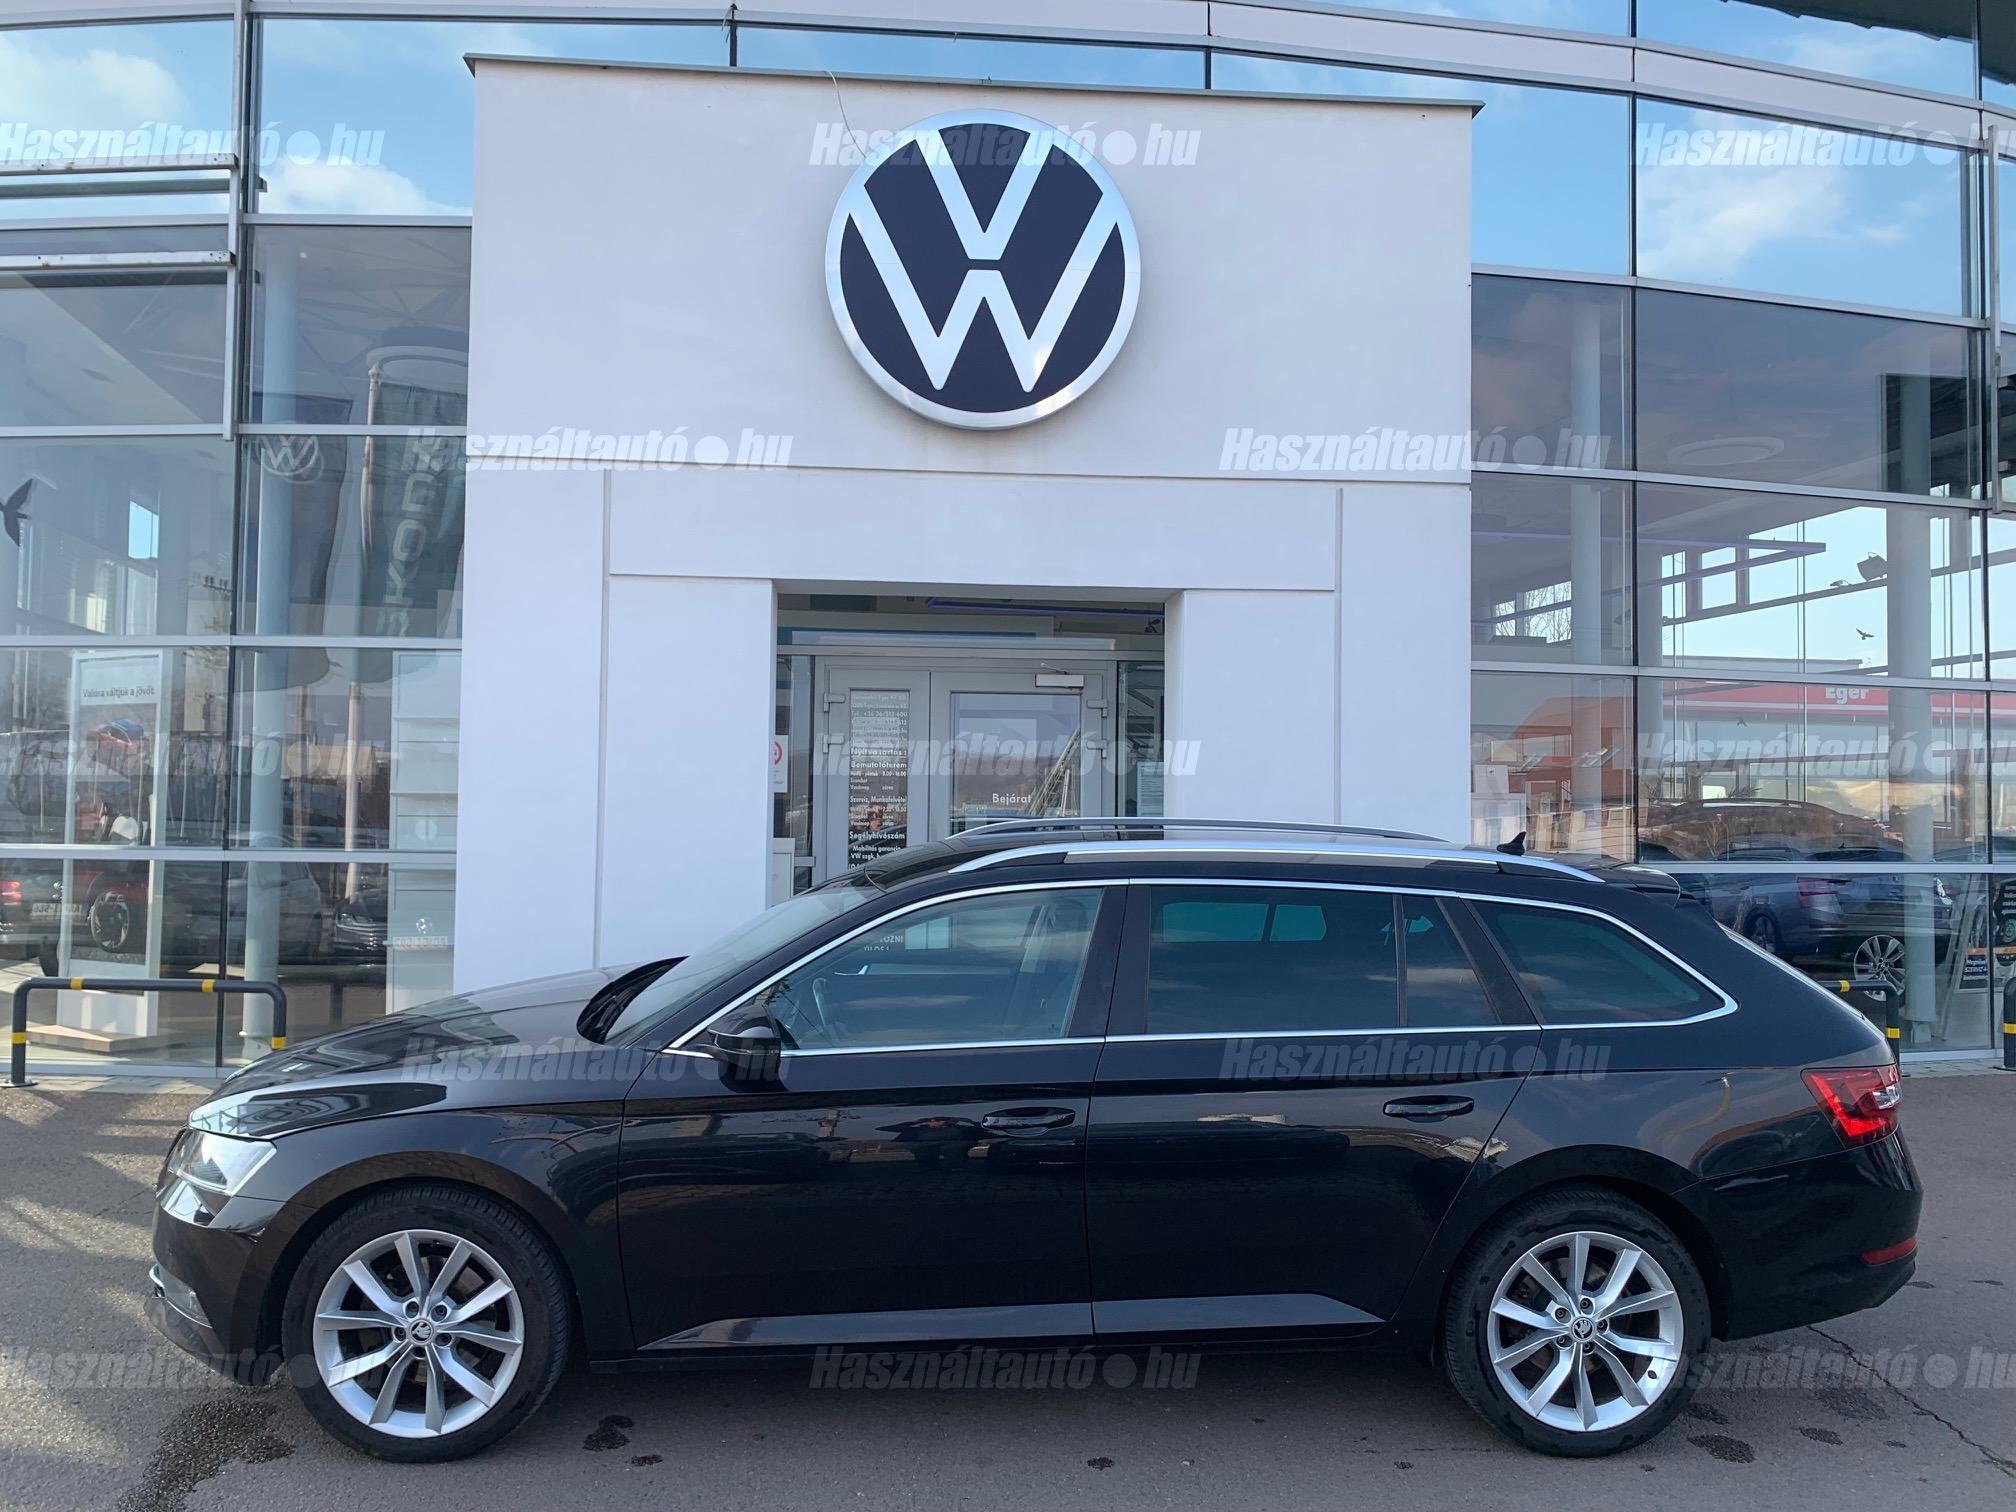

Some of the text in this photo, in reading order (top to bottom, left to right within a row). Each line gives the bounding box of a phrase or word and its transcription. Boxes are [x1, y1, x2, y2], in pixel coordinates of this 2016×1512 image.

[832, 112, 1134, 412] VW
[1825, 687, 1869, 705] Eger
[992, 792, 1032, 806] Bejárat
